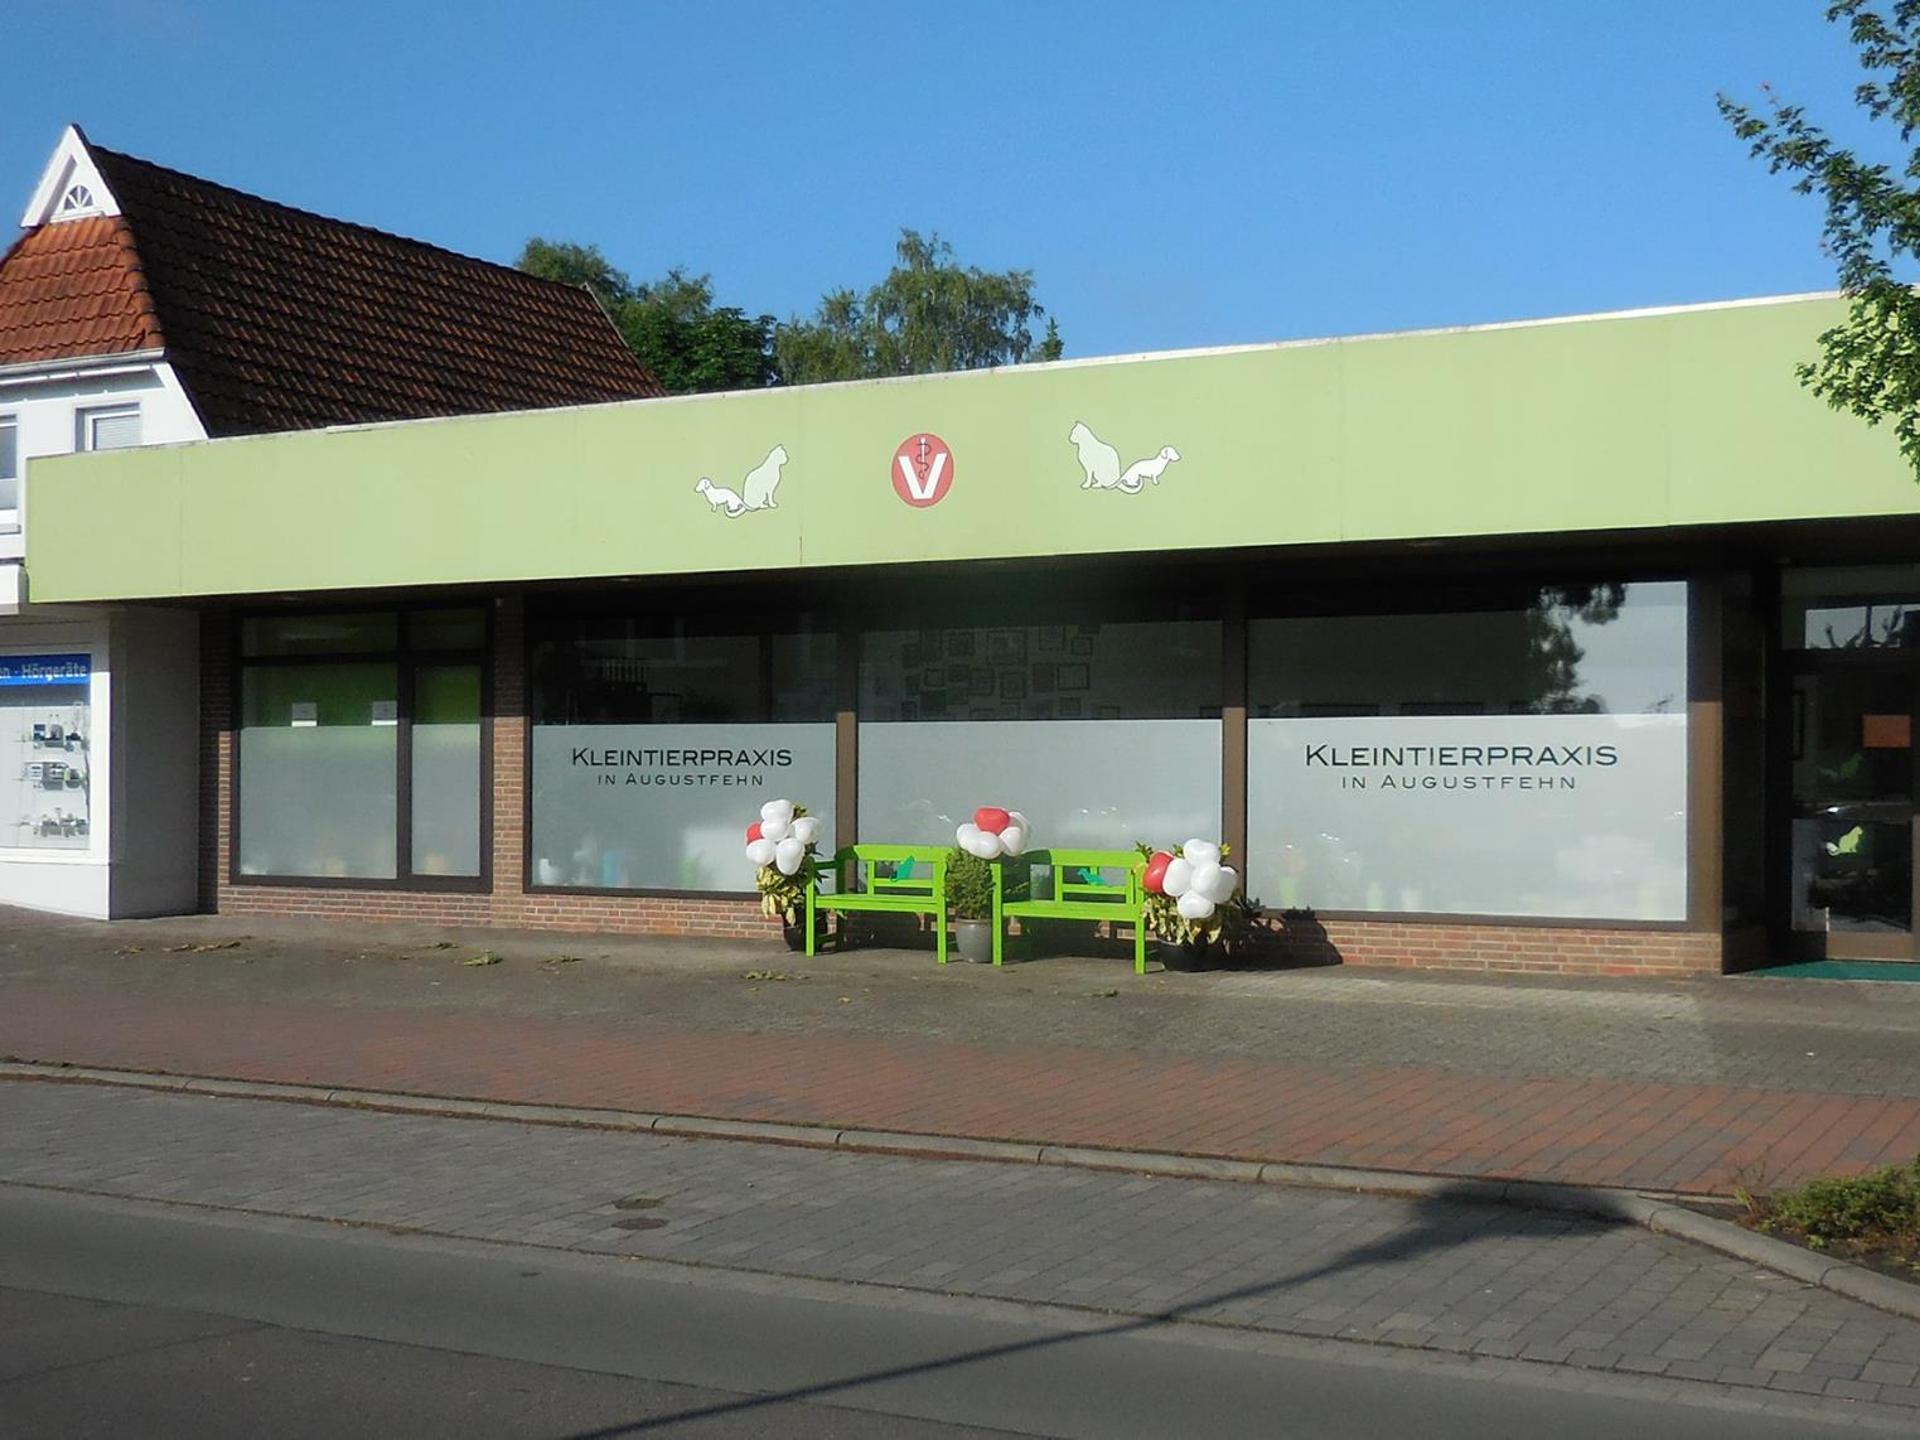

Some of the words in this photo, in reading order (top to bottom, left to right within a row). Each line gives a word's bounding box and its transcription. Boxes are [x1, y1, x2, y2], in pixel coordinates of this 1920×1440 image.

[22, 662, 87, 681] Hörgeräte
[573, 748, 792, 766] KLEINTIERPRAXIS
[1306, 745, 1618, 766] KLEINTIERPRAXIS
[598, 774, 615, 785] IN
[625, 773, 763, 785] AUGUSTFEHN
[1342, 777, 1366, 789] IN
[1381, 775, 1576, 789] AUGUSTFEHN
